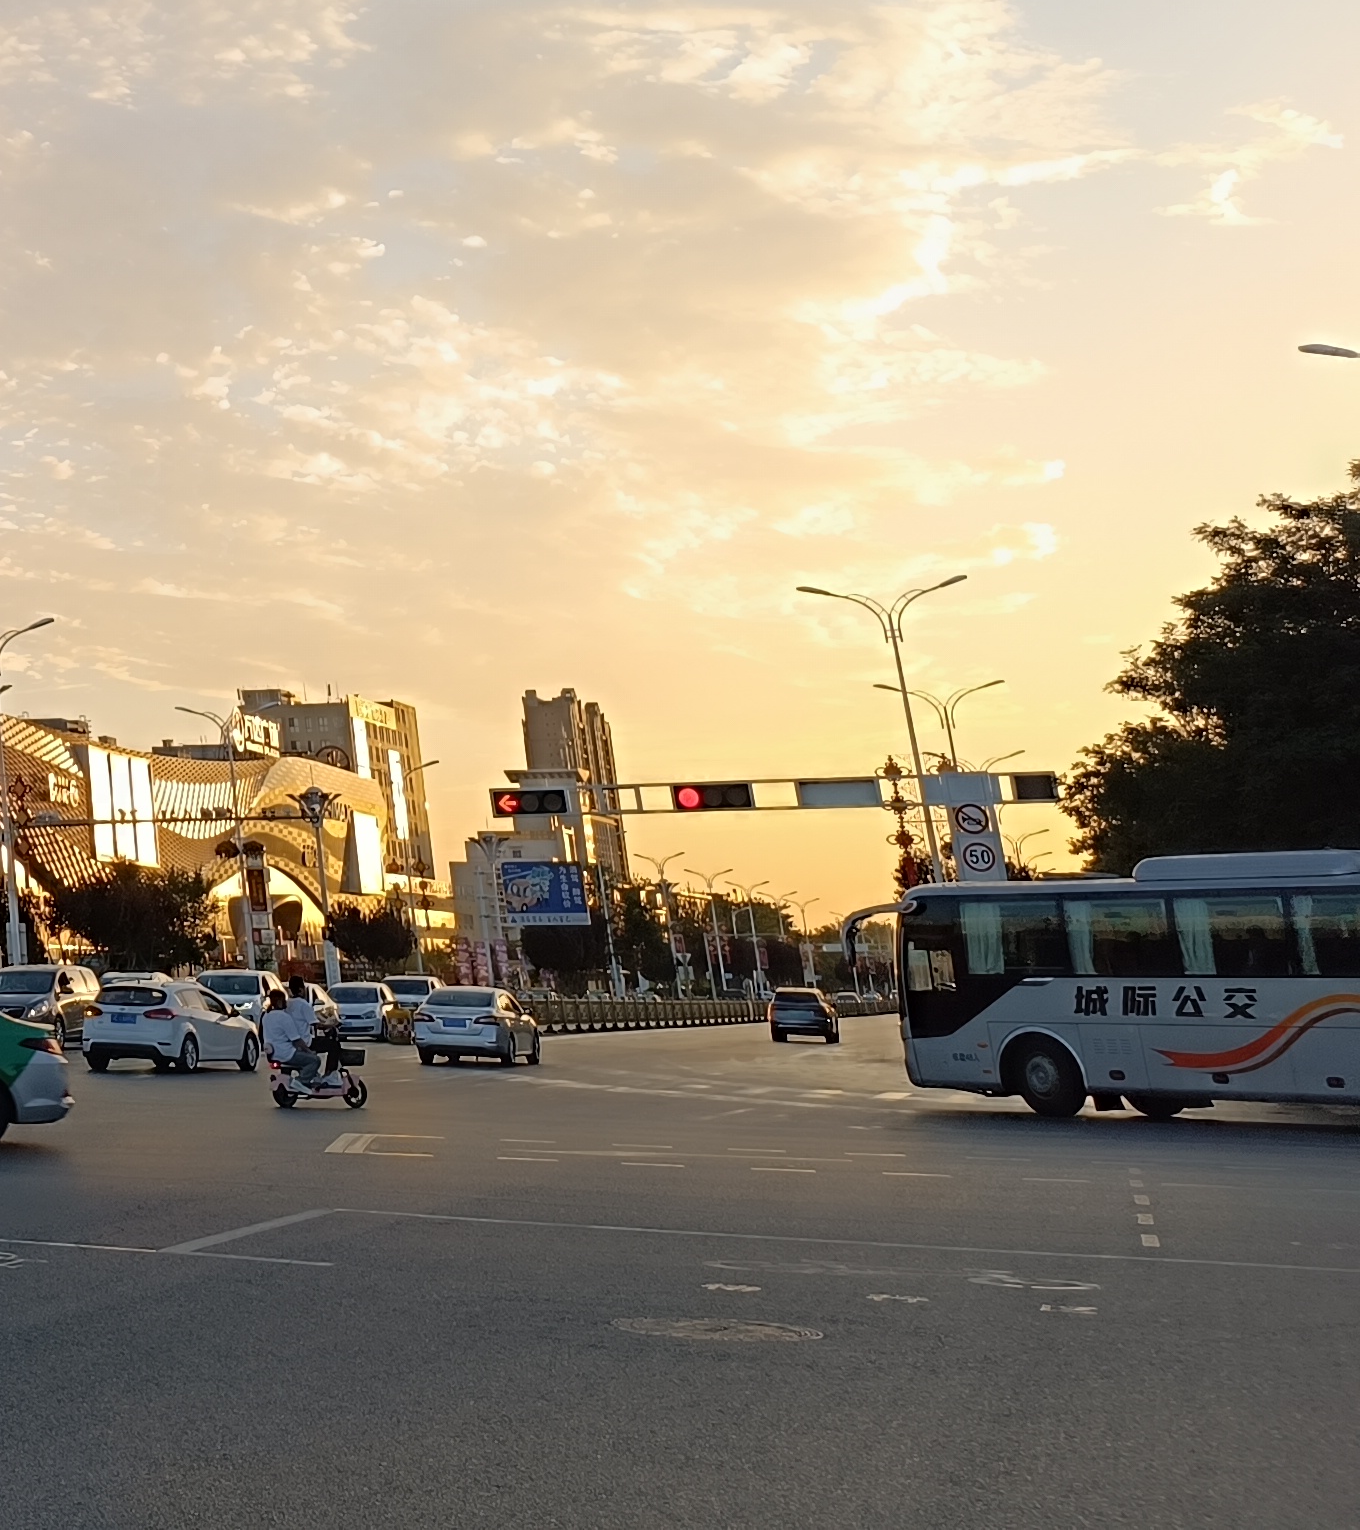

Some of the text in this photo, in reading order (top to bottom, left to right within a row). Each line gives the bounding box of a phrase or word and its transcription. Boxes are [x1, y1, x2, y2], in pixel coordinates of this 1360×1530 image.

[969, 849, 991, 865] 50
[1073, 985, 1258, 1020] 城际公交
